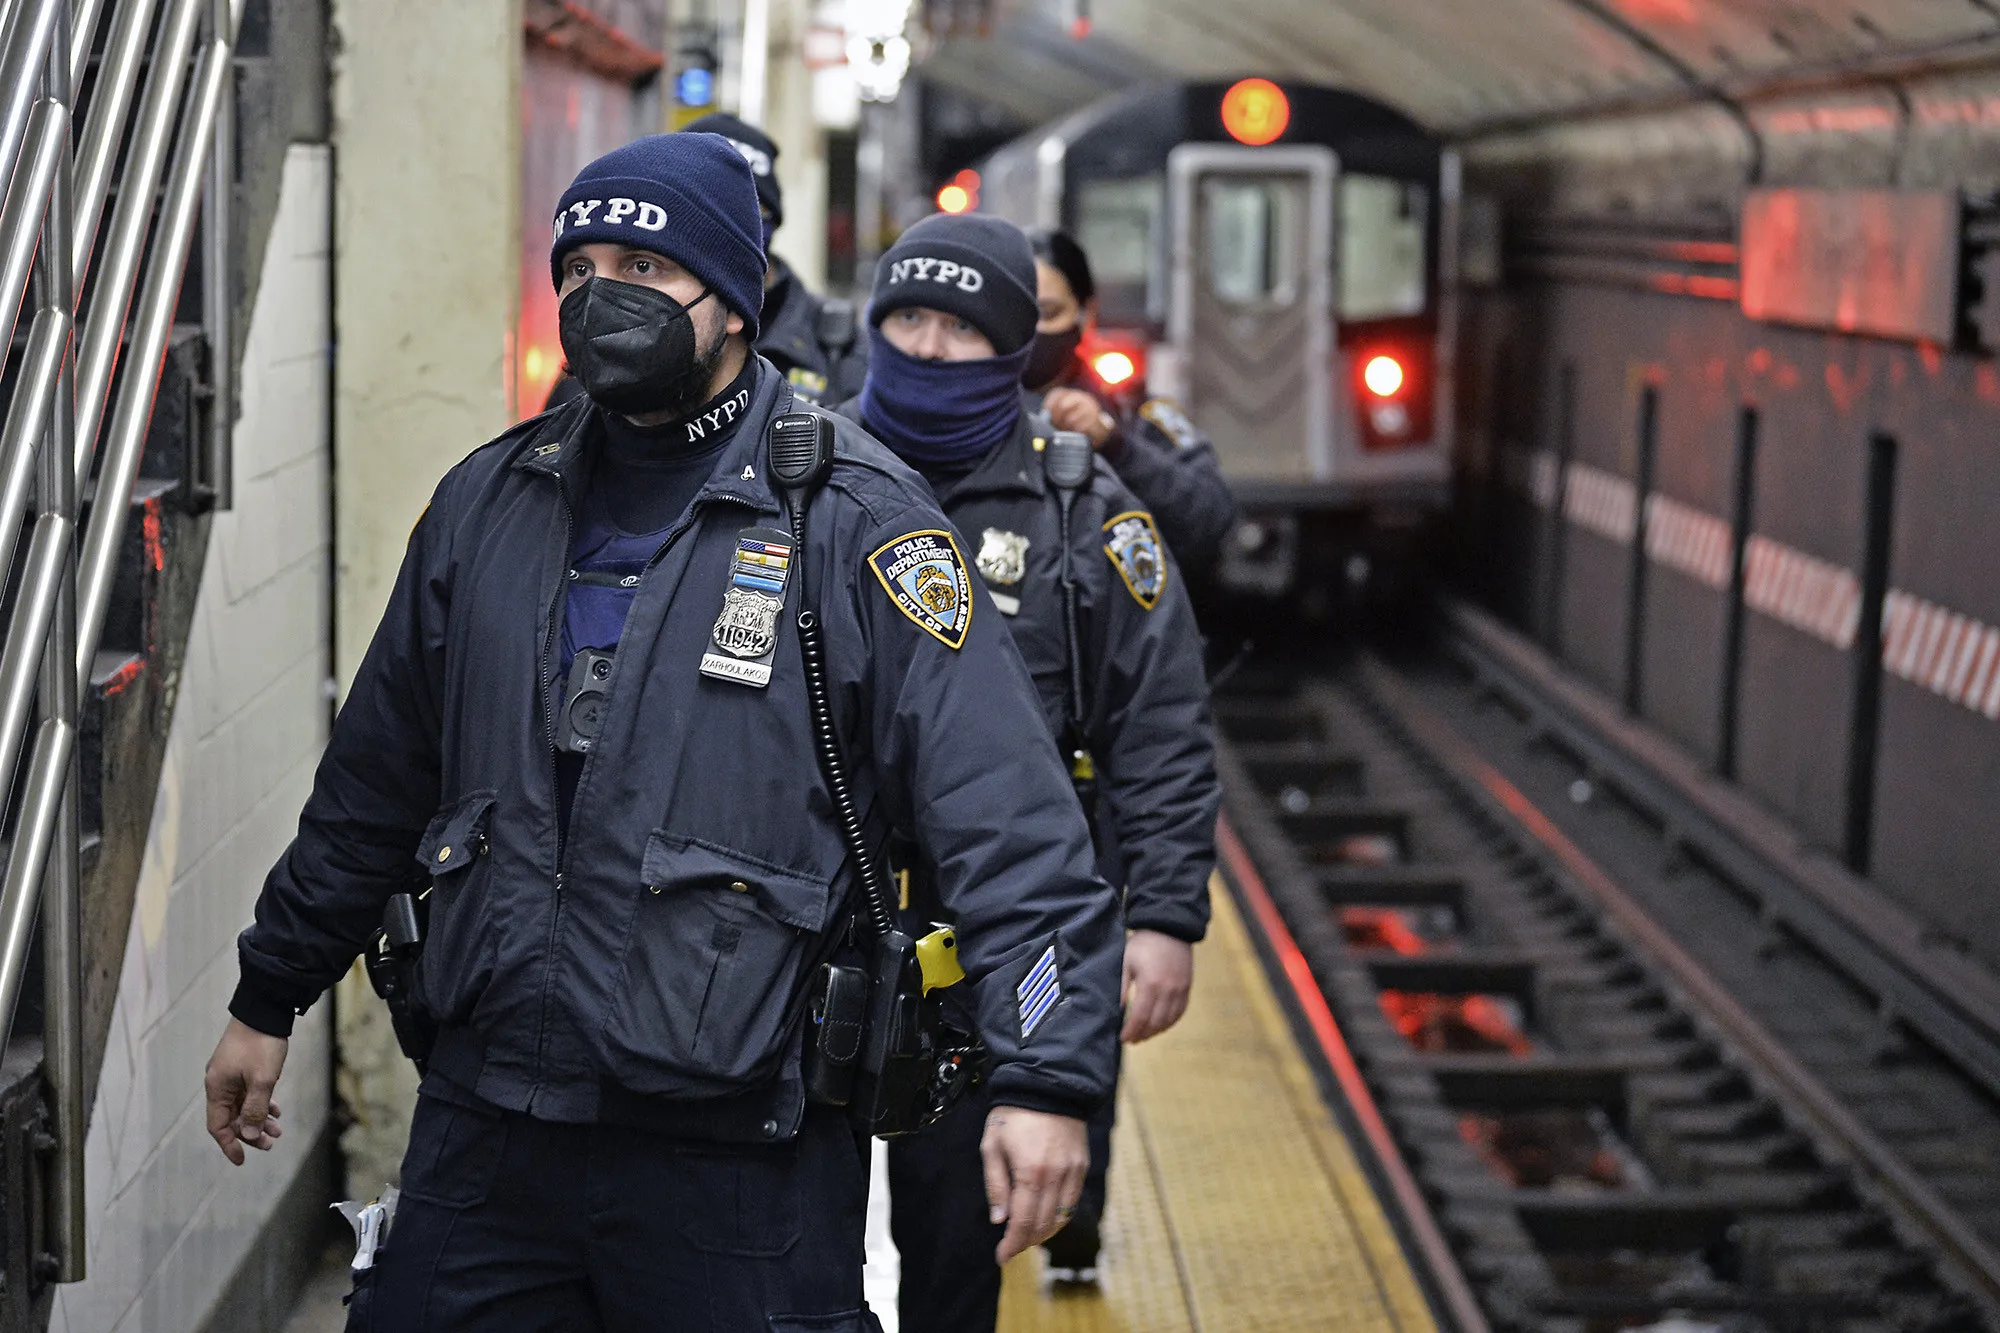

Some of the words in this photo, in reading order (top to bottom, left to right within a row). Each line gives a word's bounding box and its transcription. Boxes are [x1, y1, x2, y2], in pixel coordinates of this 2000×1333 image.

[553, 198, 668, 245] NYPD
[889, 257, 983, 293] NYPD
[684, 389, 749, 442] NYPD
[886, 548, 953, 580] DEPARTMENT
[893, 536, 936, 559] POLICE
[956, 567, 969, 603] YORK
[897, 592, 925, 618] CITY
[925, 616, 943, 632] OF
[955, 603, 968, 632] NEW
[720, 624, 767, 653] 11942
